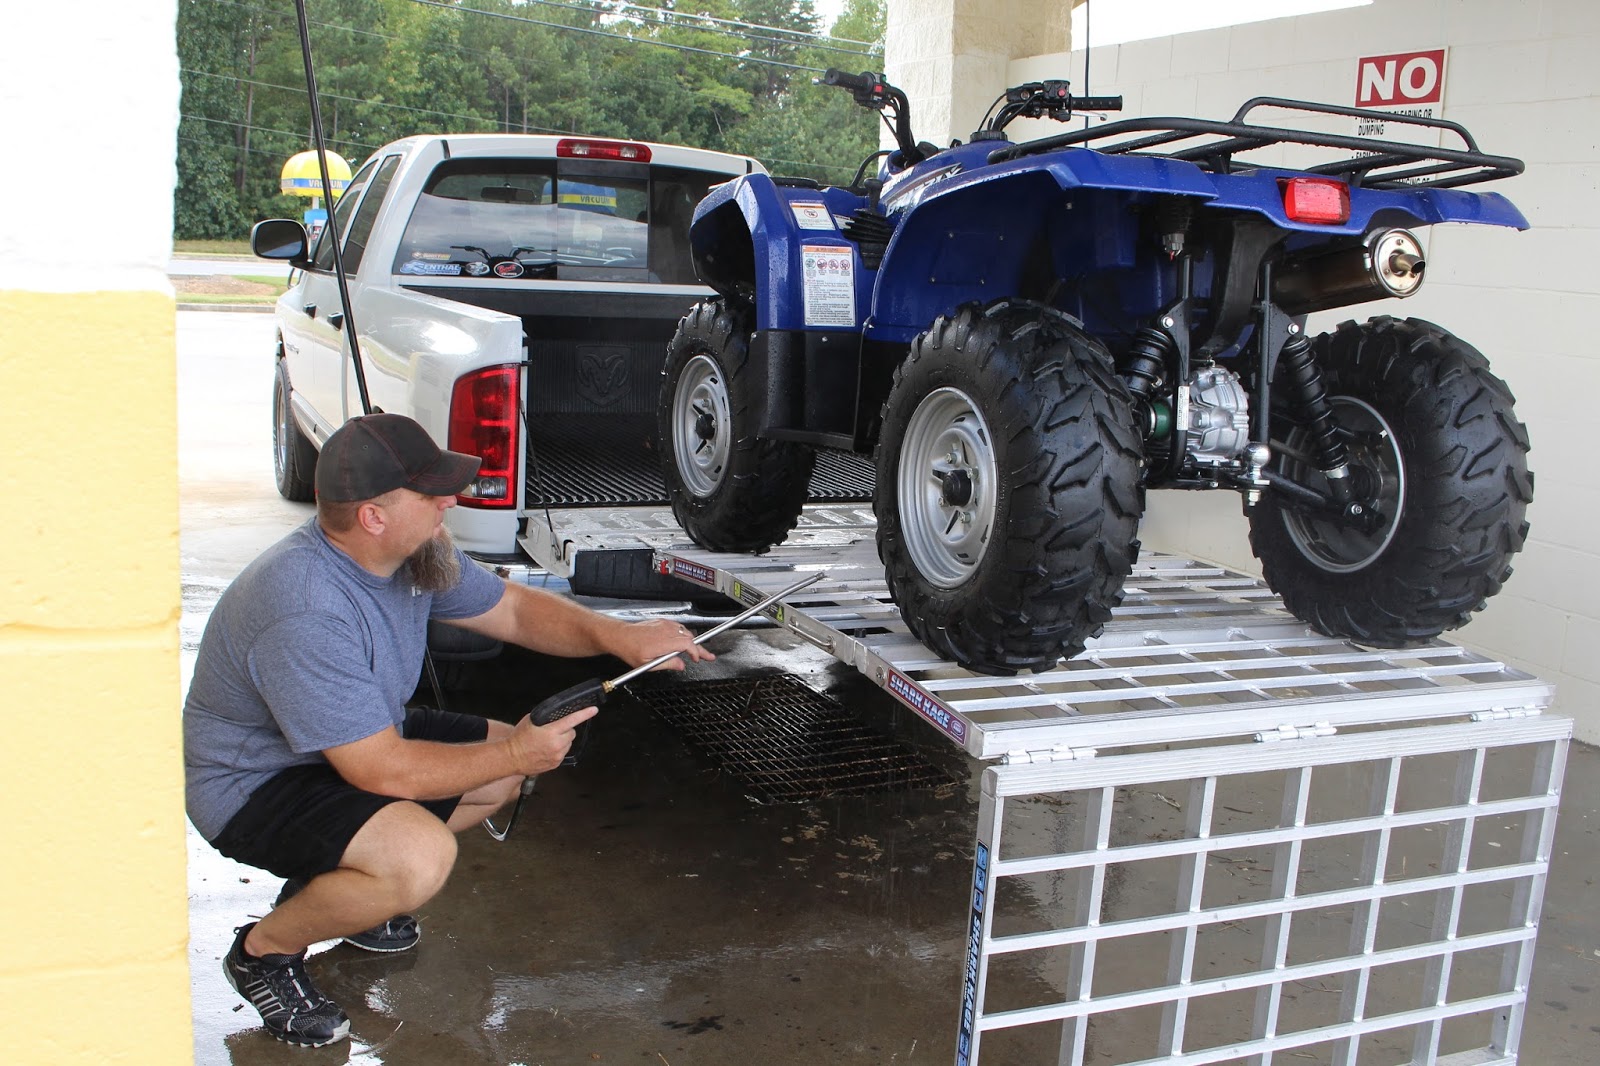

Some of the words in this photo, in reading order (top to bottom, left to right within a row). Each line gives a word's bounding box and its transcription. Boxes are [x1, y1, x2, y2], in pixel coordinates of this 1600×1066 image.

[1360, 56, 1438, 102] NO
[1358, 124, 1384, 136] DUMPING
[309, 179, 344, 188] VACUM
[890, 674, 923, 708] SHARK
[922, 697, 951, 729] KAGE
[968, 915, 981, 984] SHARK
[963, 980, 975, 1035] KAGE
